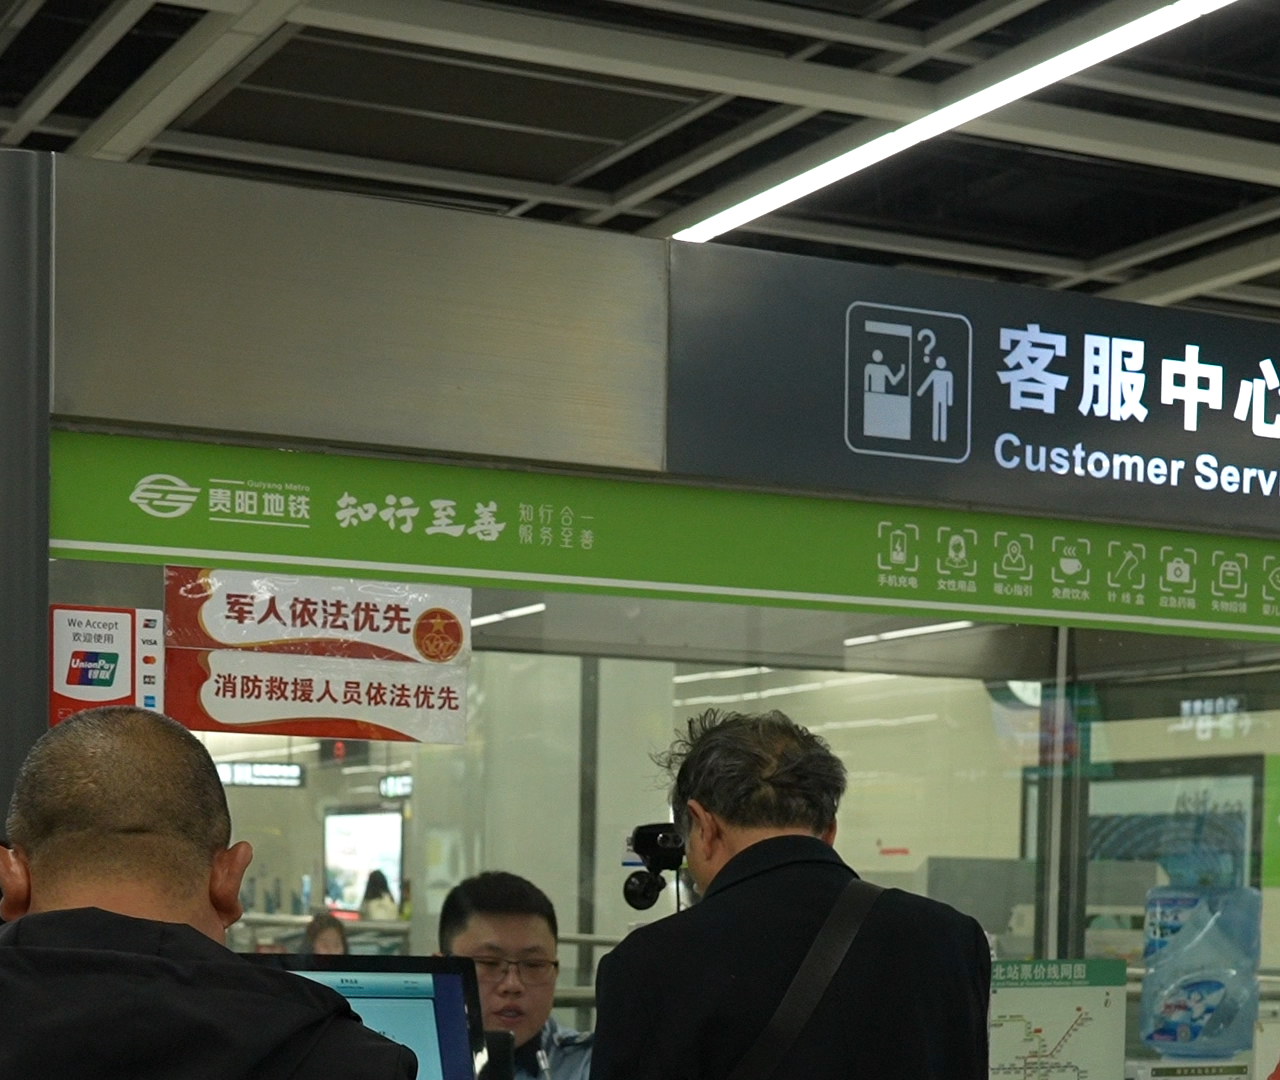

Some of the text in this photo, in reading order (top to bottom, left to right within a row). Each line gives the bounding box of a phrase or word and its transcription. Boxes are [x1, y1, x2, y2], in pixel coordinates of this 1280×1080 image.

[994, 433, 1185, 487] Customer
[247, 478, 311, 493] Guiyang Metro
[208, 487, 311, 520] 贵阳地铁
[335, 491, 507, 541] 知行至善
[519, 503, 595, 527] 知行合一
[519, 524, 595, 550] 服务至善
[877, 573, 918, 589] 手机充电
[937, 577, 977, 593] 女性用品
[1051, 587, 1090, 601] 免费饮水
[224, 592, 412, 636] 军人依法优先
[67, 618, 119, 631] We Accept
[72, 631, 115, 645] 欢迎使用
[70, 658, 116, 672] UnionPay
[214, 673, 460, 712] 消防救援人员依法优先
[993, 963, 1087, 981] 北站票价线网图
